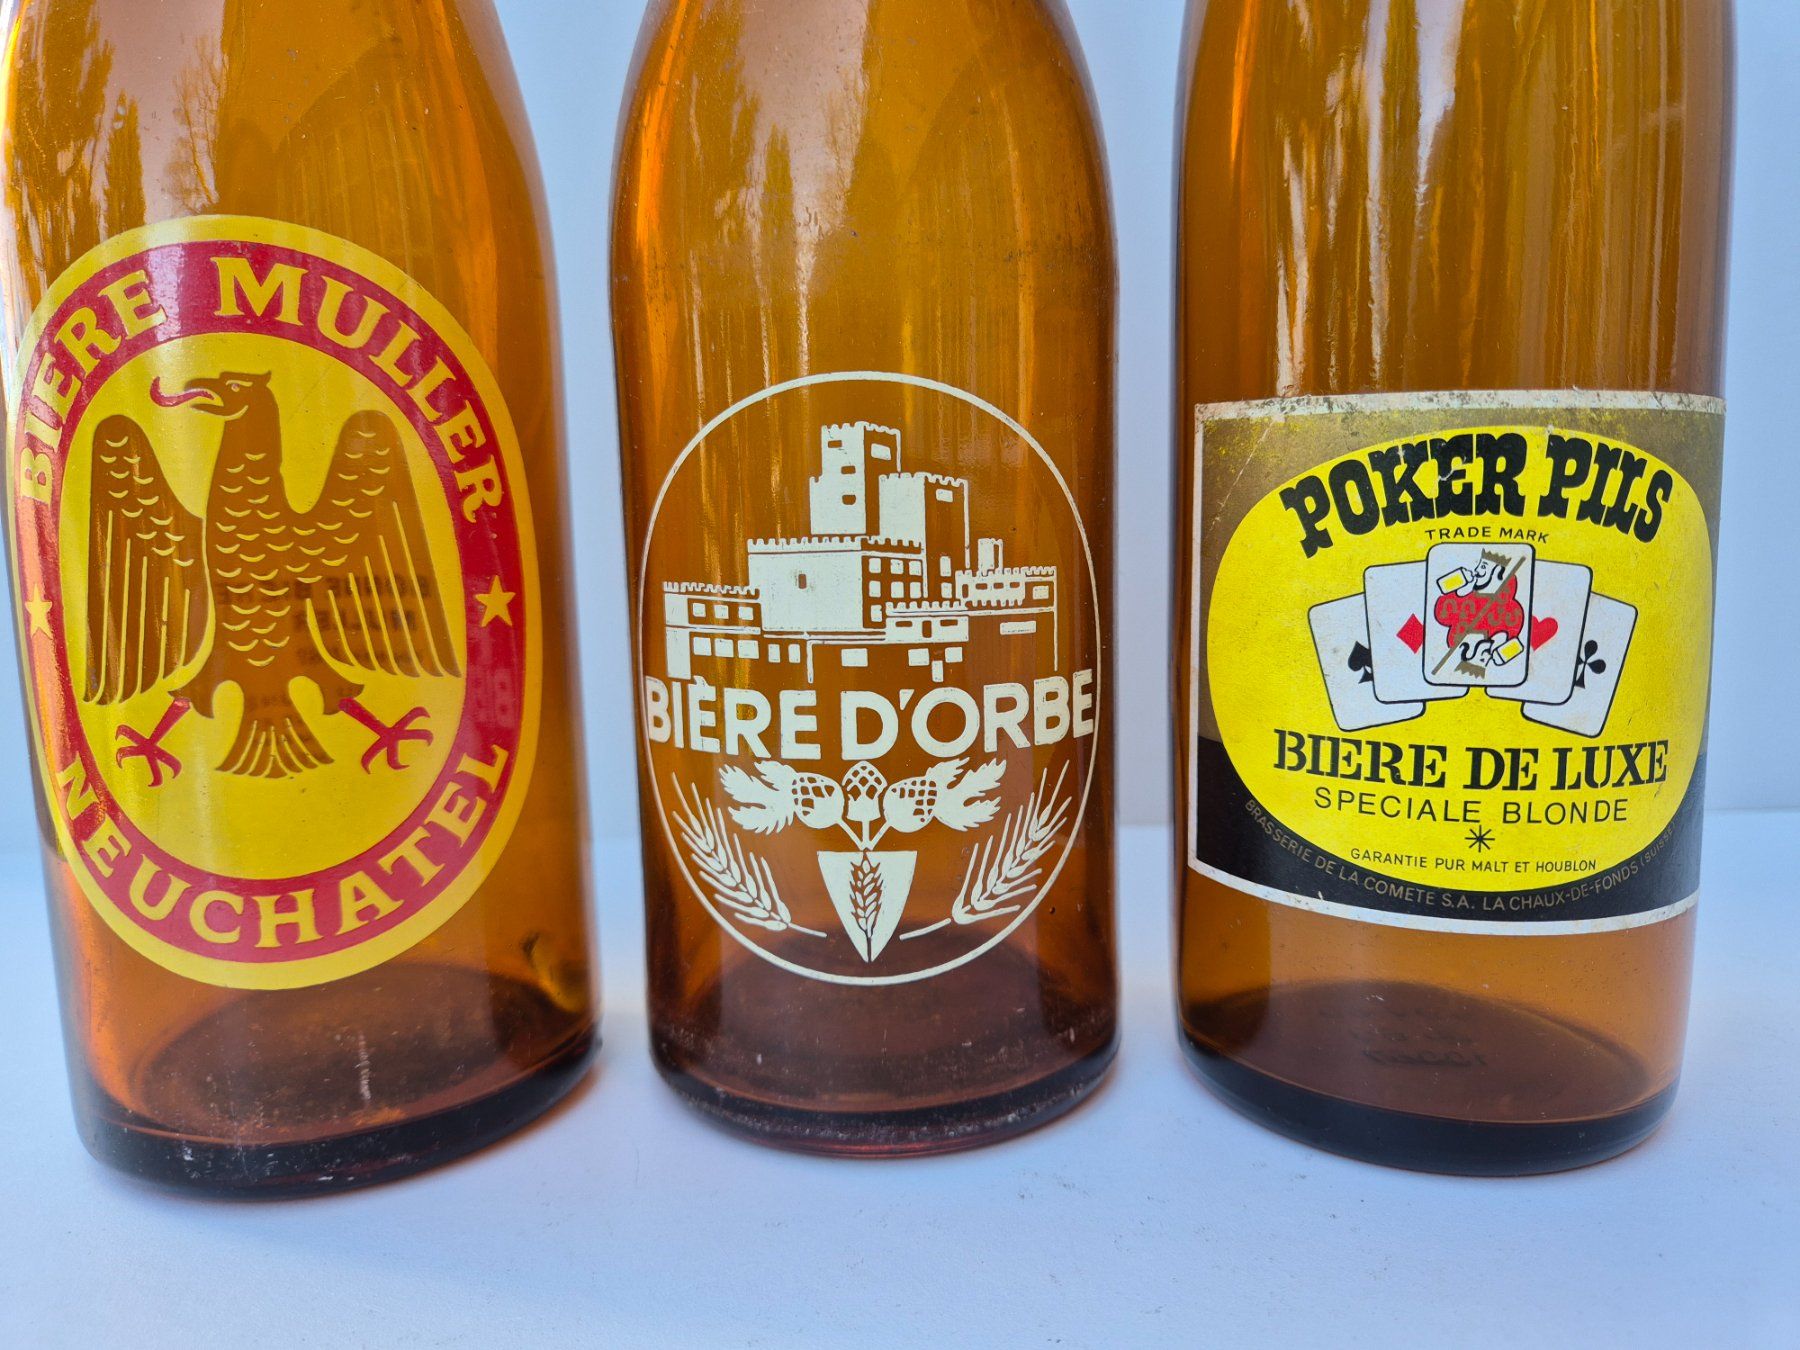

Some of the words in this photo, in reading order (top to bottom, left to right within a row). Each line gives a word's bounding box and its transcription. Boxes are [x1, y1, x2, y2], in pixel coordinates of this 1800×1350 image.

[20, 269, 168, 508] BIERE
[210, 256, 503, 525] MULLER
[1279, 431, 1528, 559] POKER
[1537, 433, 1673, 544] PILS
[1424, 526, 1492, 540] TRADE
[1499, 529, 1550, 544] MARK
[645, 674, 822, 760] BIÈRE
[840, 668, 1096, 761] D'ORBE
[1273, 728, 1447, 788] BIERE
[1462, 746, 1539, 791] DE
[1549, 739, 1670, 791] LUXE
[57, 743, 509, 949] NEUCHATEL
[1313, 786, 1482, 823] SPECIALE
[1502, 798, 1629, 825] BLONDE
[1244, 799, 1311, 863] BRASSERIE
[1314, 855, 1335, 875] DE
[1338, 865, 1360, 886] LA
[1363, 876, 1436, 906] COMETE
[1482, 896, 1506, 911] LA
[1508, 859, 1640, 911] CHAUX-DE-FONDS
[1350, 847, 1428, 869] GARANTIE
[1434, 857, 1466, 872] PUR
[1471, 860, 1509, 873] MALT
[1514, 861, 1531, 873] ET
[1536, 859, 1597, 873] HOUBLON
